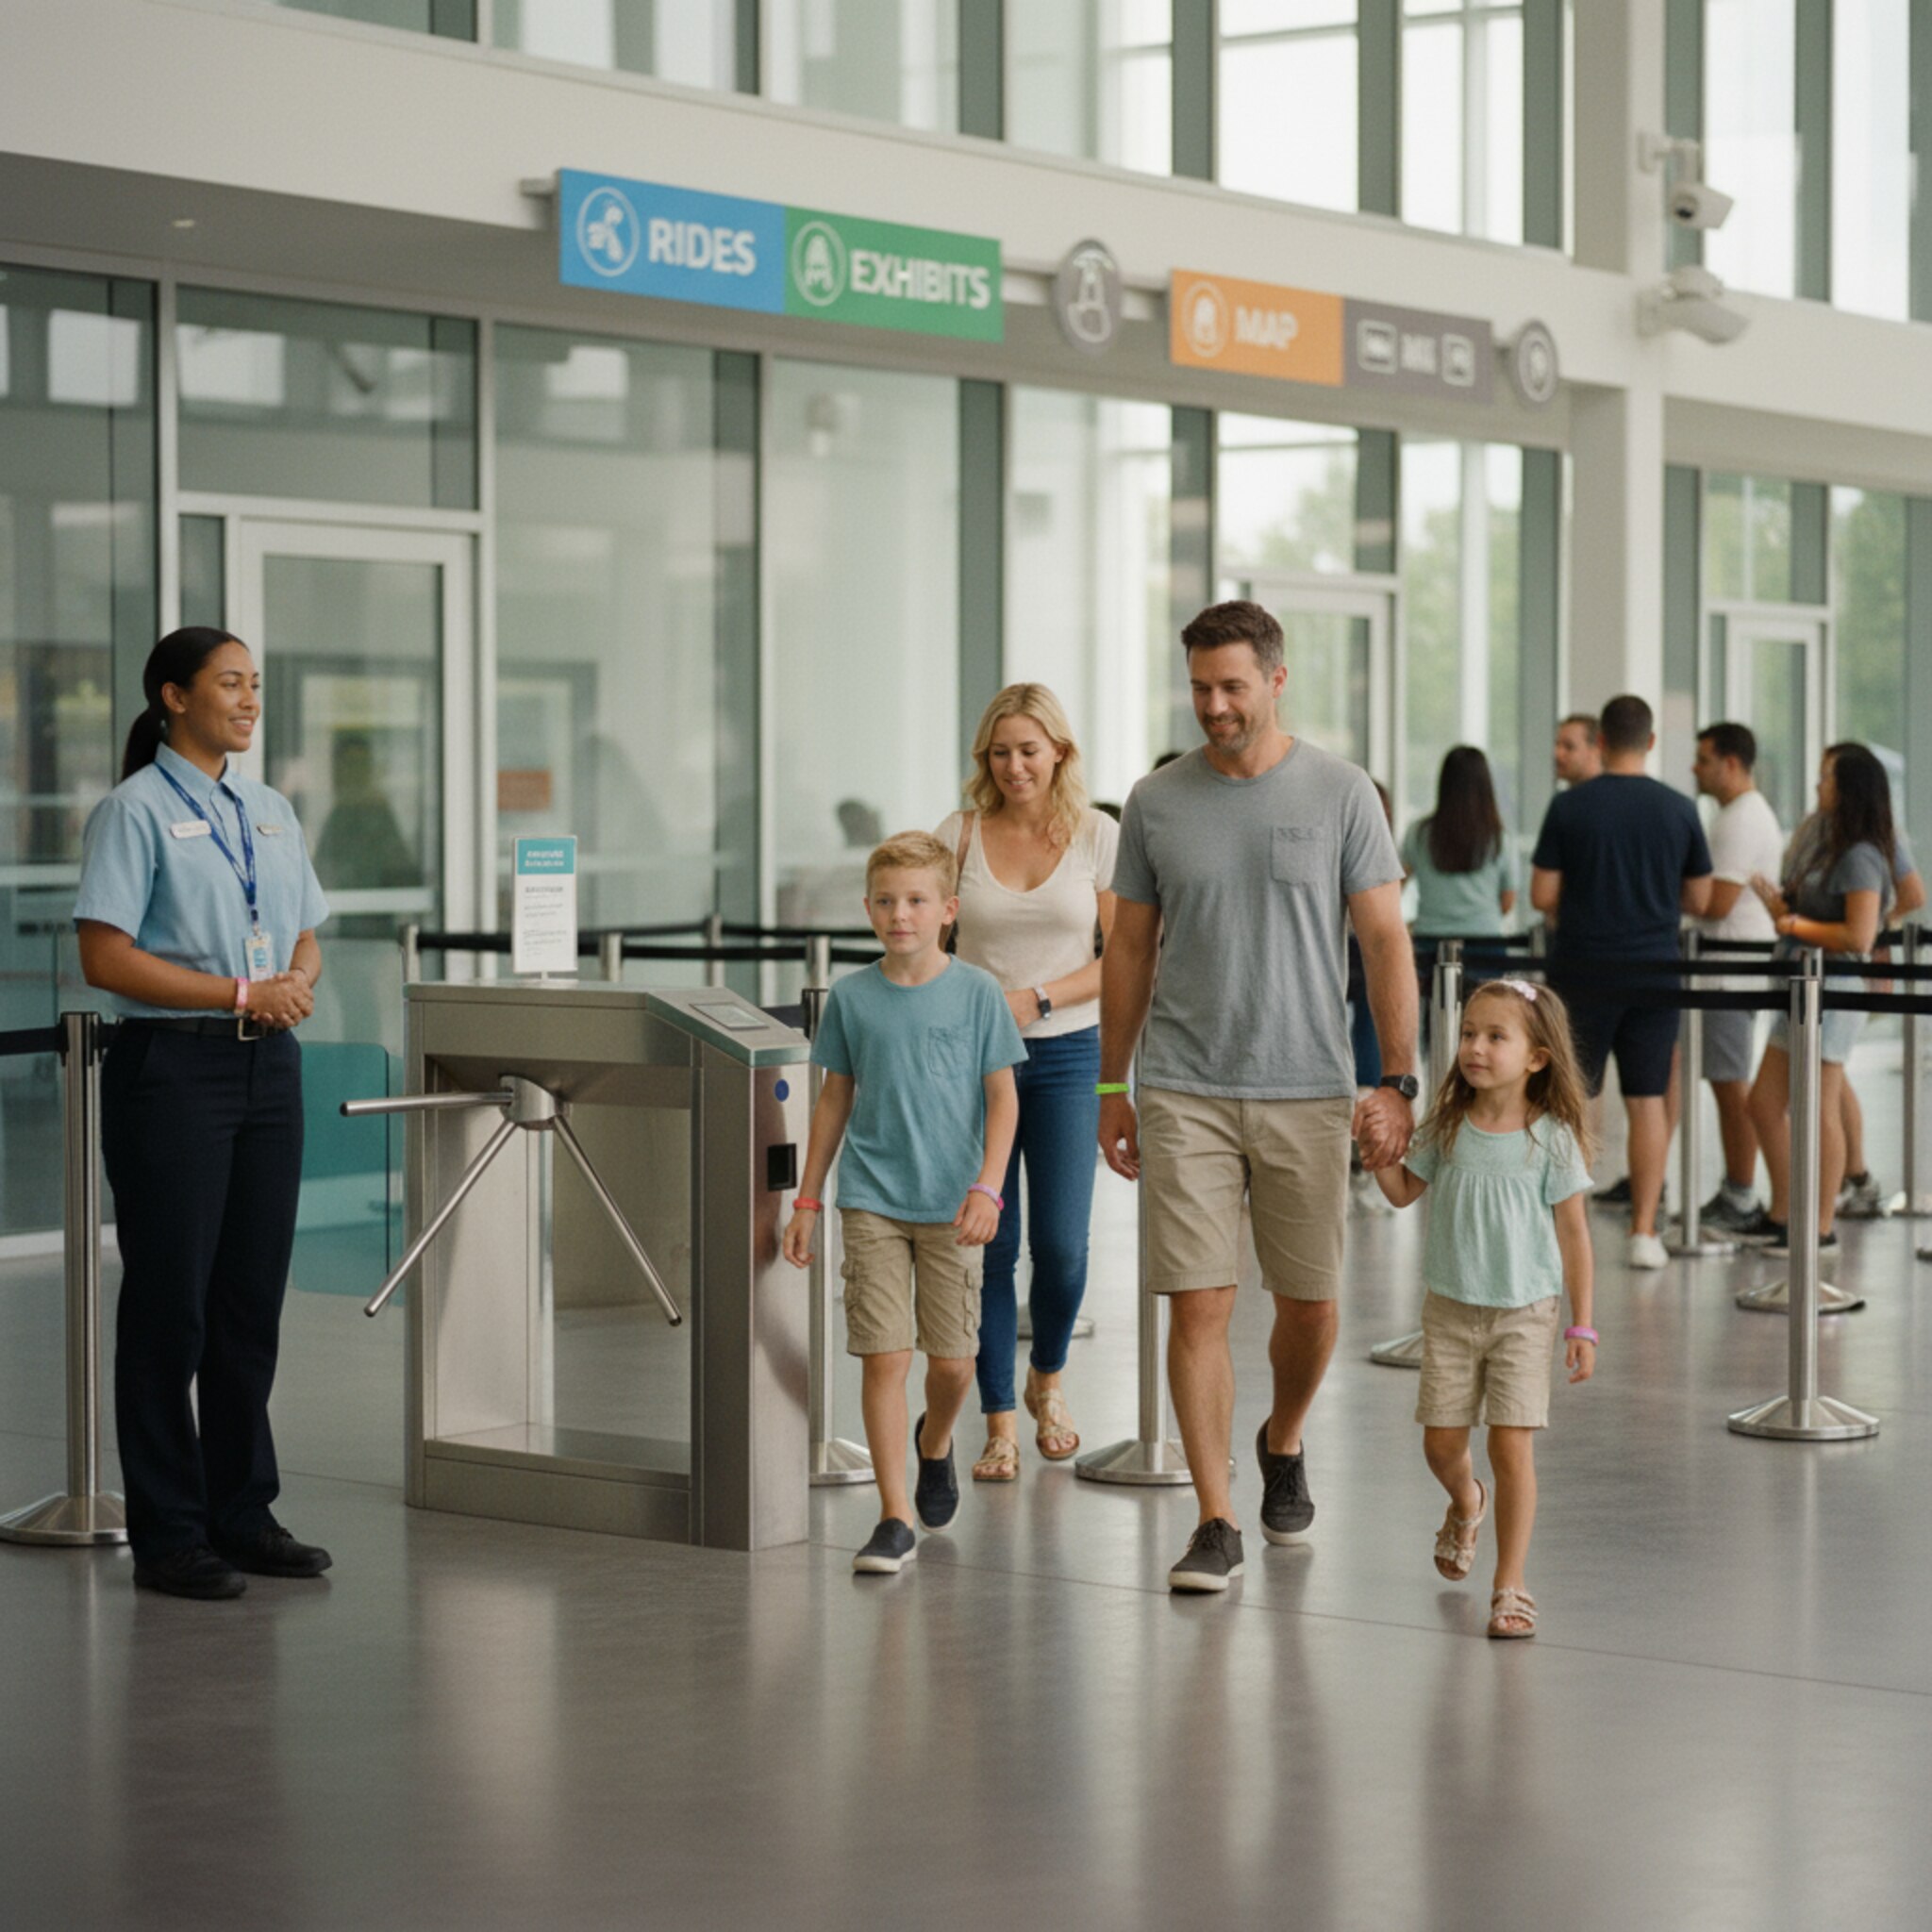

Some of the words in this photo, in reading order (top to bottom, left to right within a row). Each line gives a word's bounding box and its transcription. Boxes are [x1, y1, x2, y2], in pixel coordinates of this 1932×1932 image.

[648, 217, 756, 275] RIDES
[852, 249, 991, 309] EXHIBITS
[1236, 306, 1297, 350] MAP
